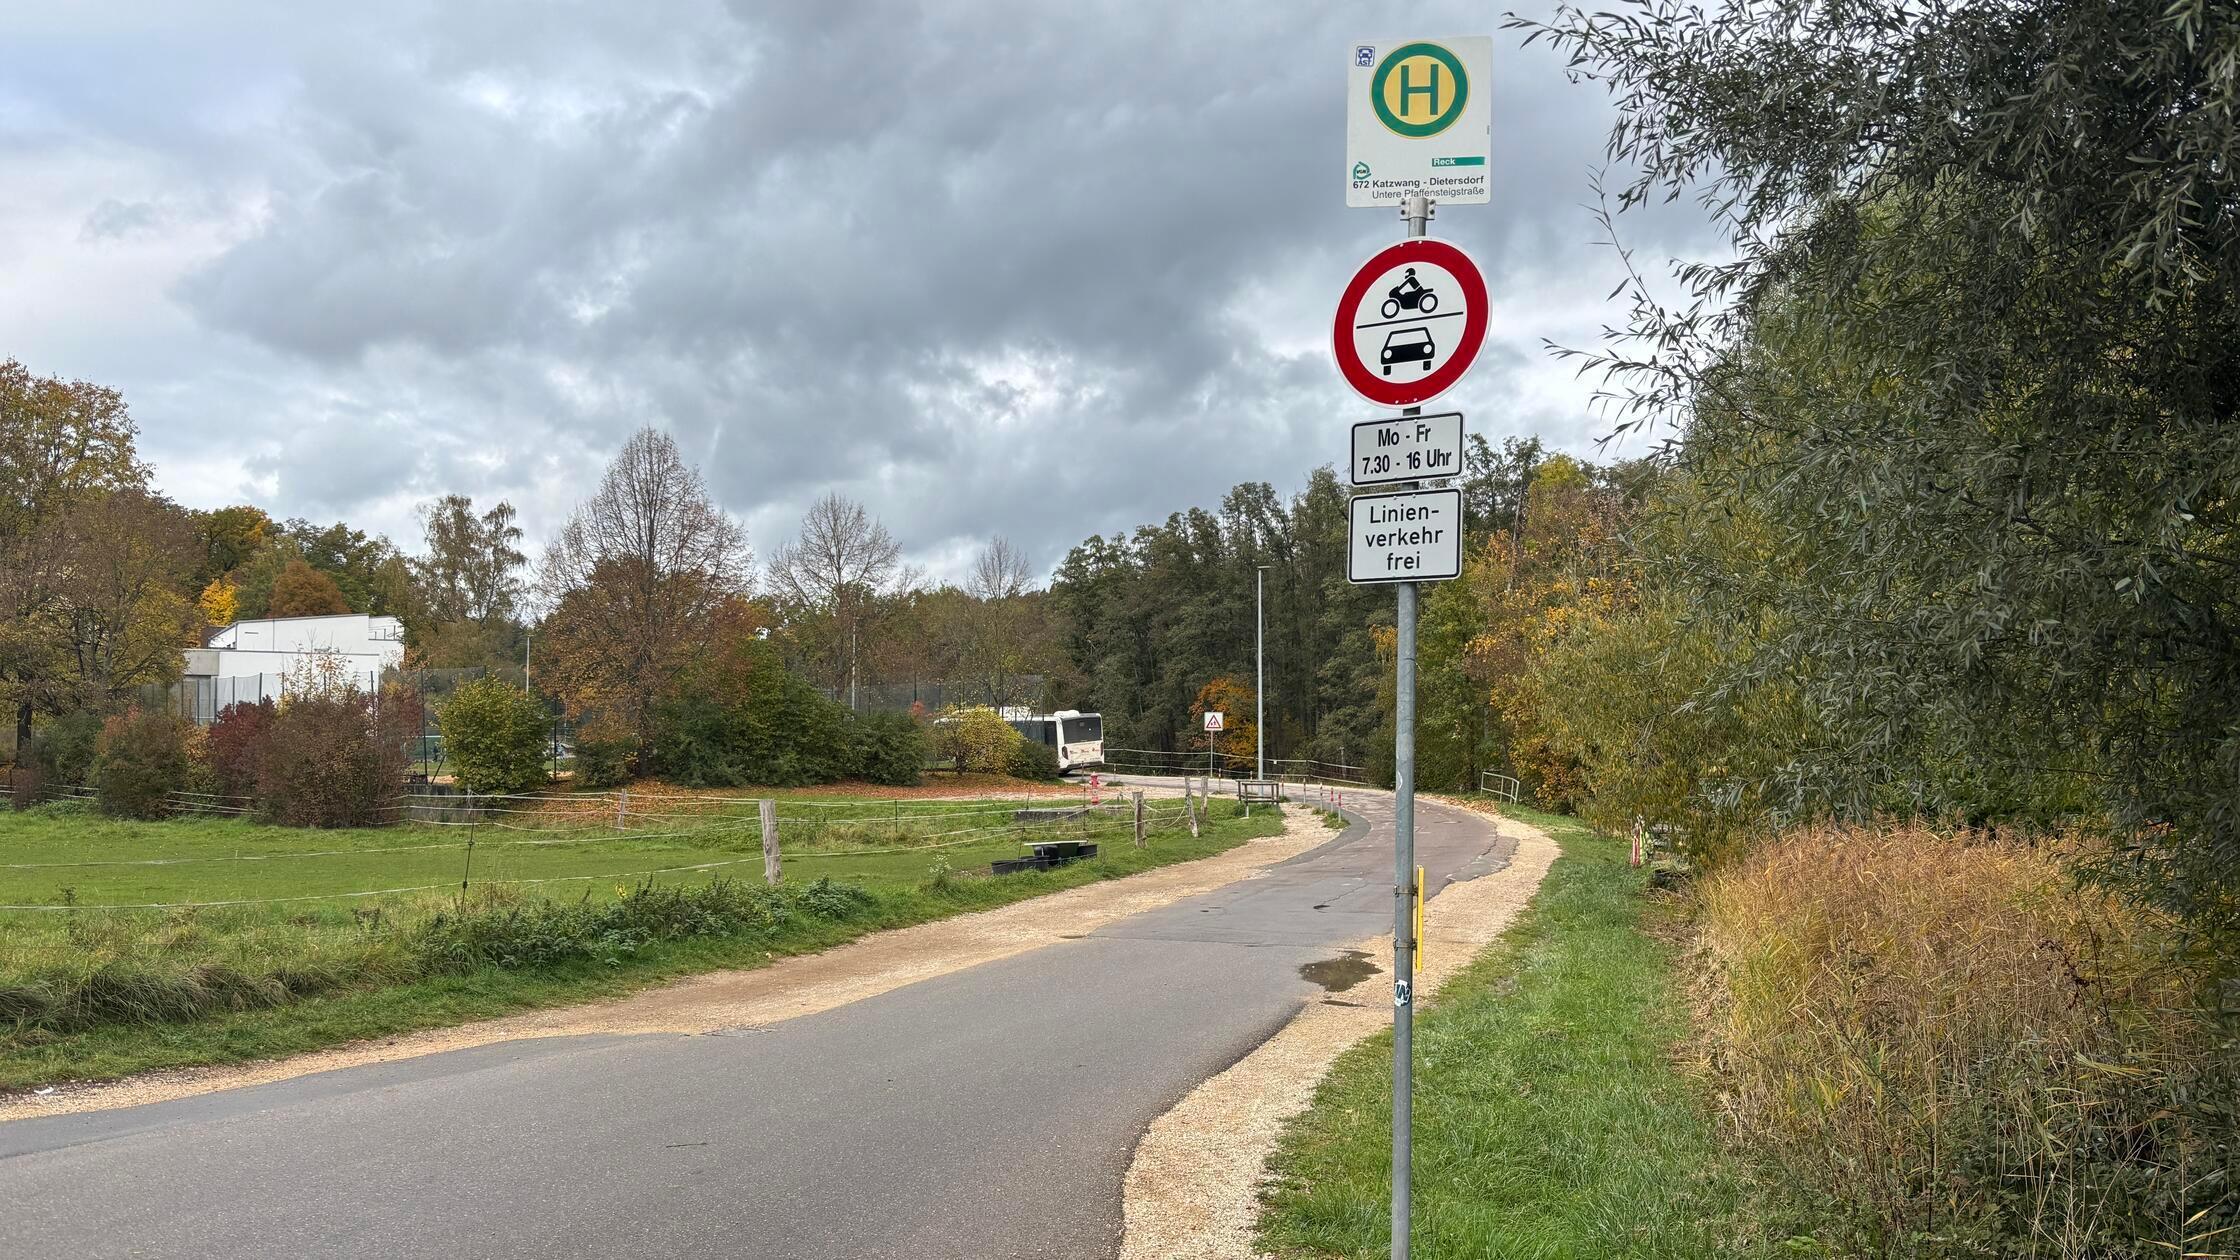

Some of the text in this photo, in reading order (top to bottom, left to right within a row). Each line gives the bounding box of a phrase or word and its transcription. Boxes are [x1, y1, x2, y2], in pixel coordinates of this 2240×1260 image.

[1400, 64, 1439, 116] H
[1353, 180, 1370, 189] 672
[1372, 179, 1420, 188] Katzwang
[1430, 175, 1484, 186] Dietersdorf
[1372, 186, 1485, 199] Untere Pfaffensteigstraße
[1378, 428, 1399, 447] Mo
[1416, 424, 1431, 443] Fr
[1362, 454, 1390, 474] 7.30
[1406, 451, 1420, 470] 16
[1427, 449, 1452, 468] Uhr
[1370, 503, 1440, 524] Linien-
[1365, 526, 1443, 548] verkehr
[1387, 551, 1420, 571] frei
